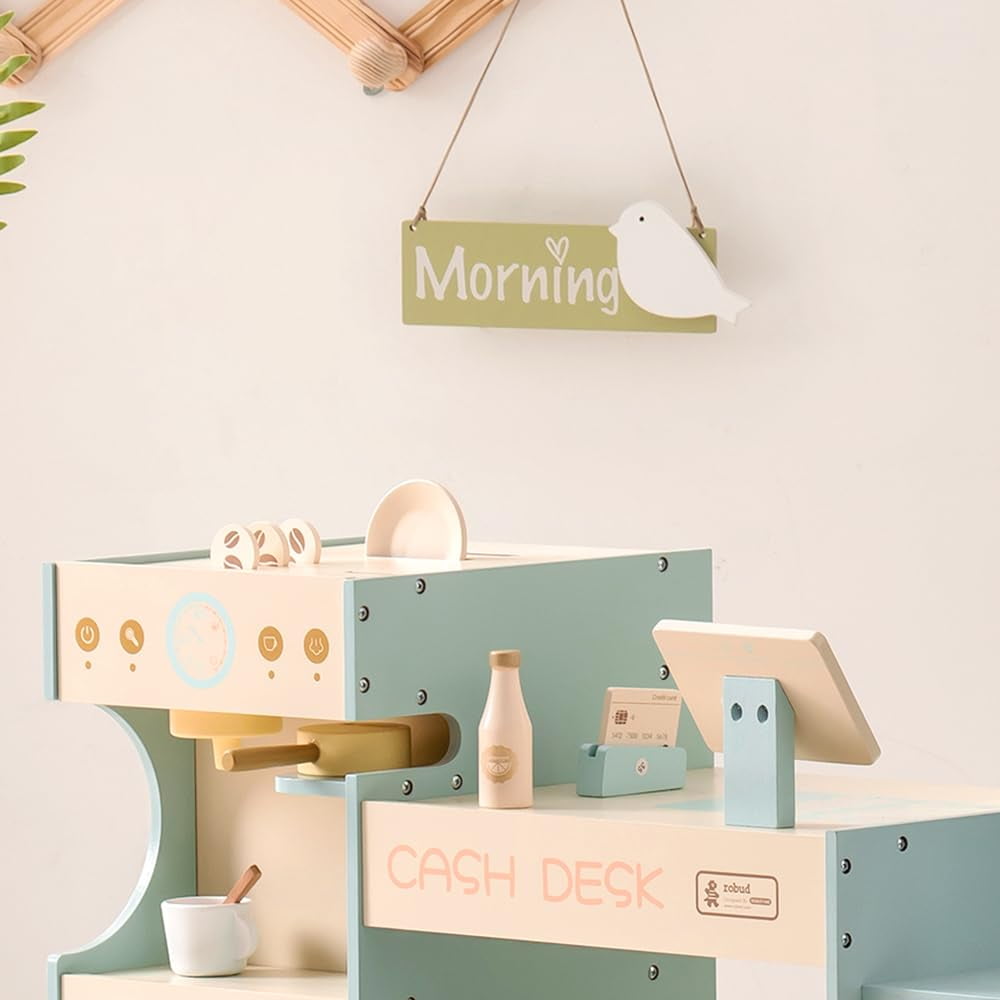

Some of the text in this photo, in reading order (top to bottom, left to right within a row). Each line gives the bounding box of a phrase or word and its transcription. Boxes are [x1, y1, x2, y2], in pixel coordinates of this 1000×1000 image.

[416, 237, 618, 315] Morning
[387, 844, 665, 909] CASH DESK
[723, 882, 751, 894] robud
